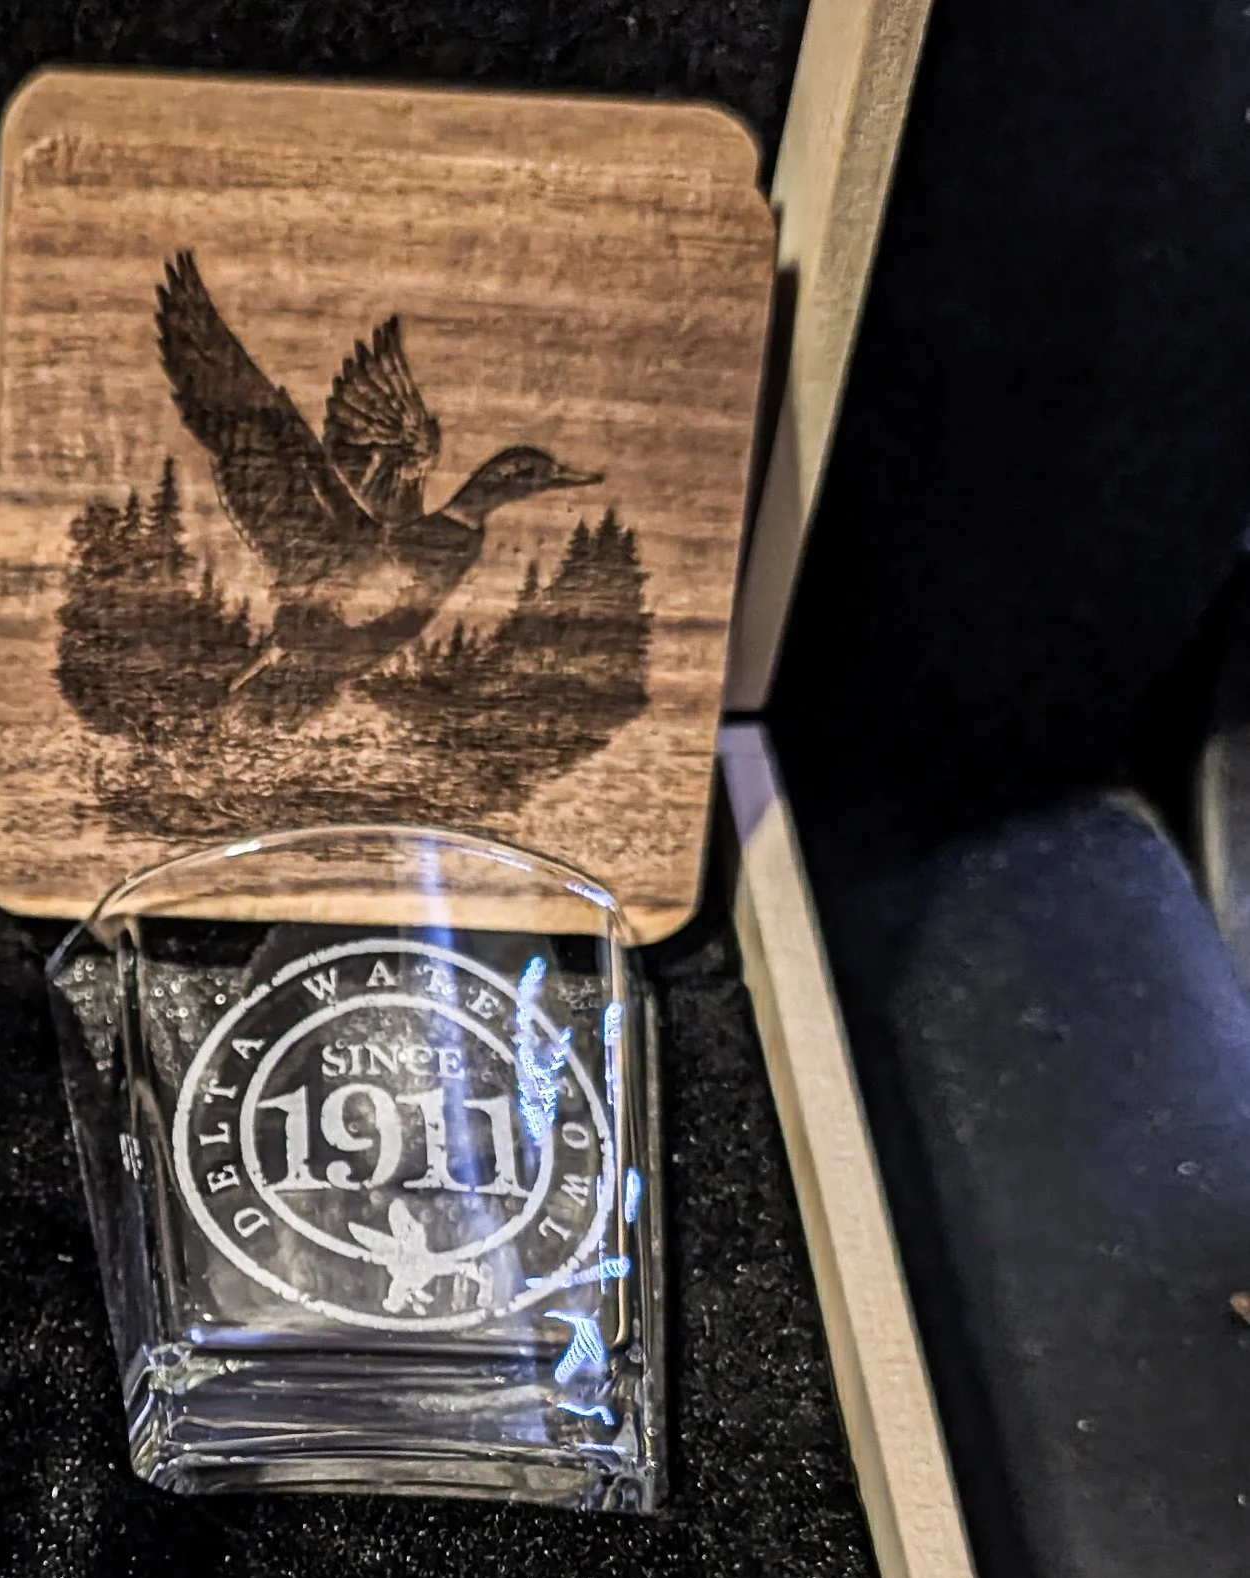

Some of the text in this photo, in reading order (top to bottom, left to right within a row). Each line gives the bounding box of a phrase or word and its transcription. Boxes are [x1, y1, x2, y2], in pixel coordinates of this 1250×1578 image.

[200, 960, 591, 1241] DELTA WATEOWL
[321, 1043, 466, 1080] SINCE
[256, 1083, 529, 1198] 1911
